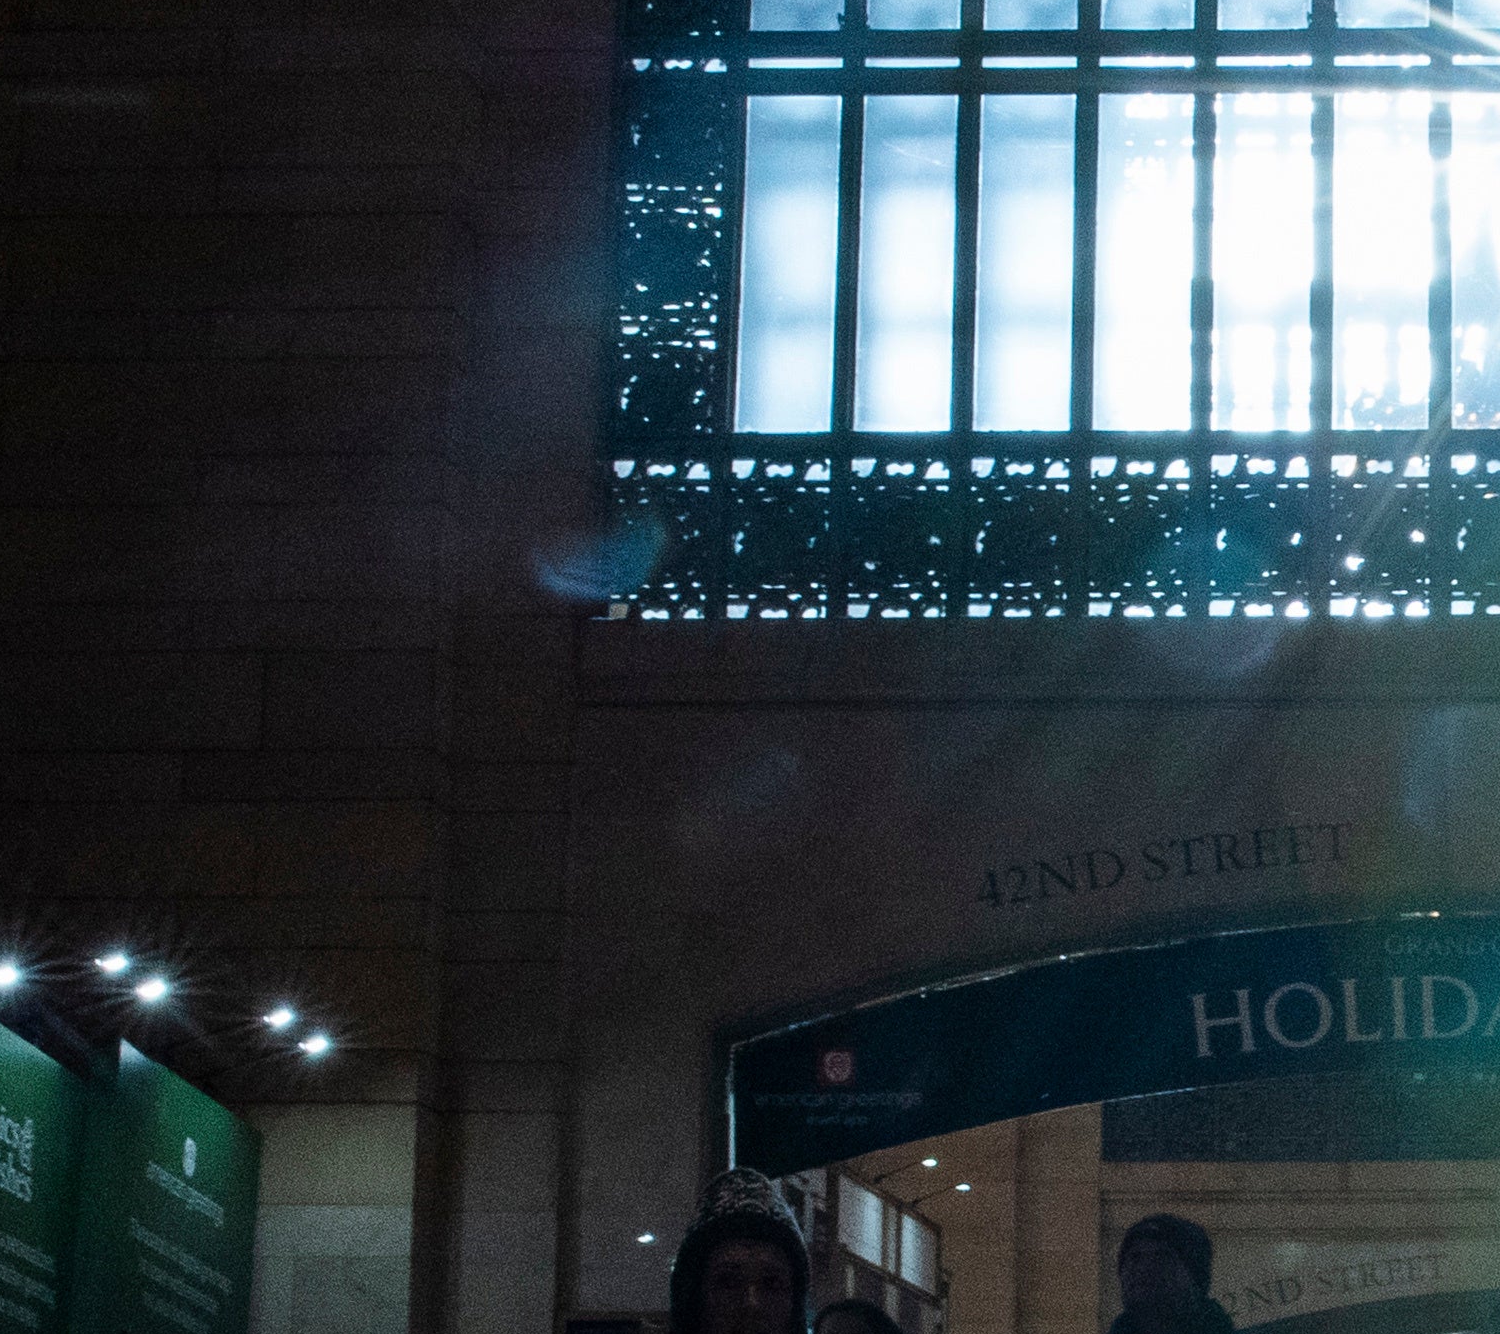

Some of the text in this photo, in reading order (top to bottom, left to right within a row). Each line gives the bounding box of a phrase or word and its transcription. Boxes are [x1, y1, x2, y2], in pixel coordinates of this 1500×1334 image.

[977, 848, 1126, 908] 42ND
[1141, 822, 1353, 883] STREET
[1222, 1252, 1449, 1318] 2ND STREET
